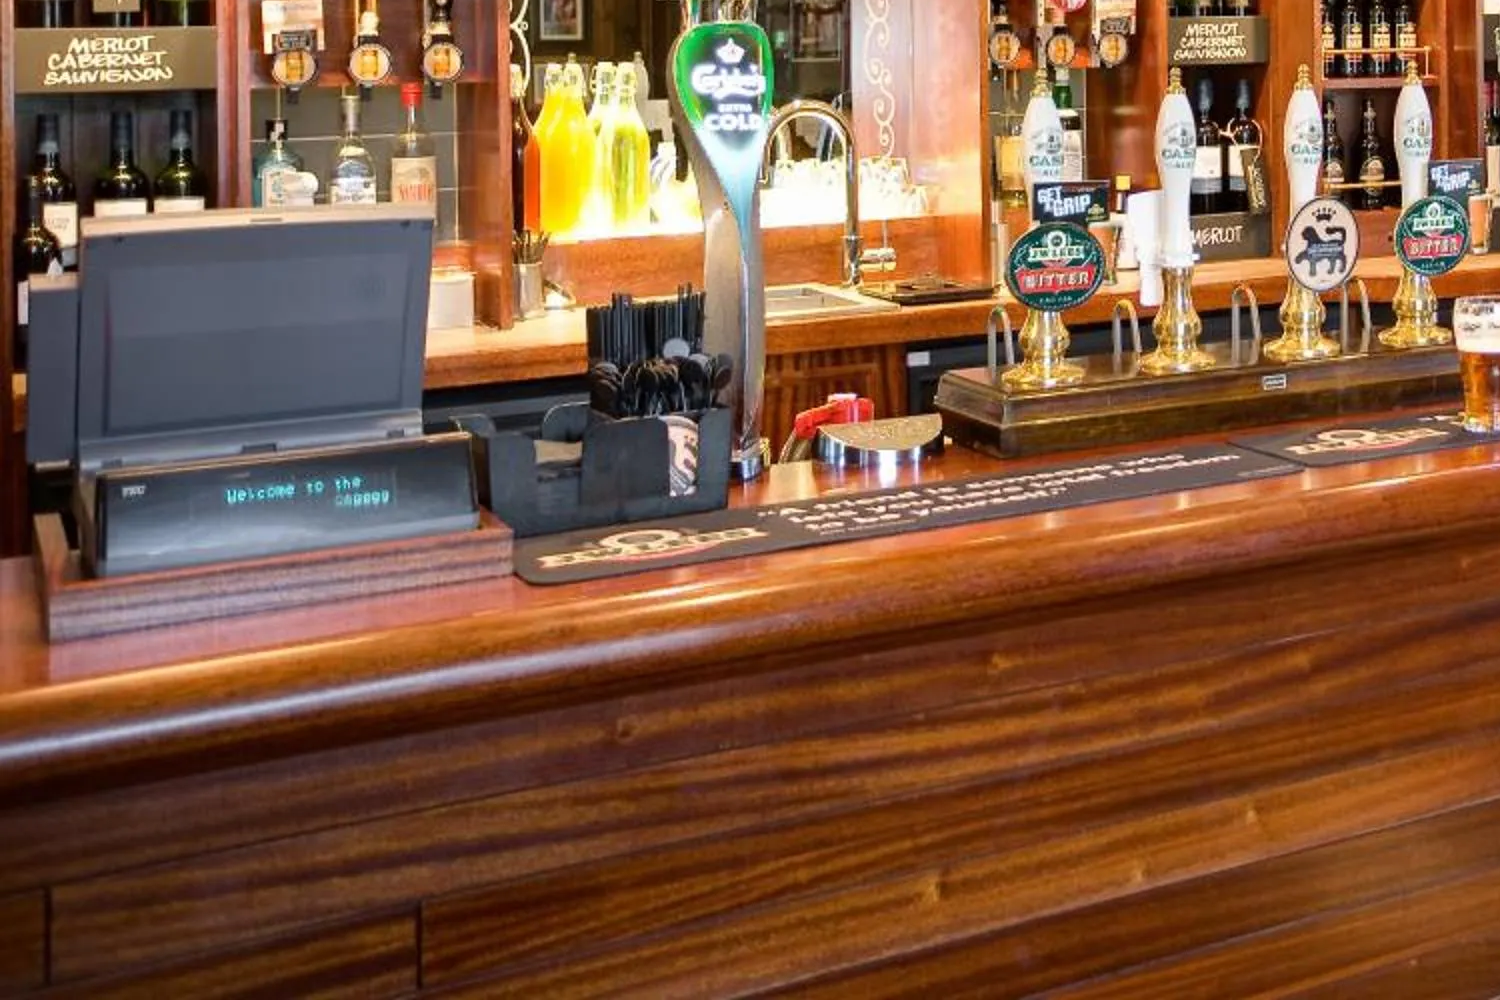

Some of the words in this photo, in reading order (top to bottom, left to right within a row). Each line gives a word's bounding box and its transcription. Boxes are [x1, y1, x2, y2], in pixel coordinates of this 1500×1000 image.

[1186, 23, 1239, 37] MERLOT
[67, 34, 157, 55] MERLOT
[1181, 35, 1246, 48] CABERNET
[47, 50, 169, 71] CABERNET
[1173, 47, 1247, 61] SAUVIGNON
[43, 66, 173, 86] SAUVIGNON
[1038, 186, 1063, 204] GET
[1053, 194, 1090, 217] GRIP
[1410, 239, 1459, 256] BITTER
[1023, 271, 1089, 288] BITTER
[225, 484, 296, 504] Welcome
[307, 480, 324, 494] to
[334, 475, 362, 491] the
